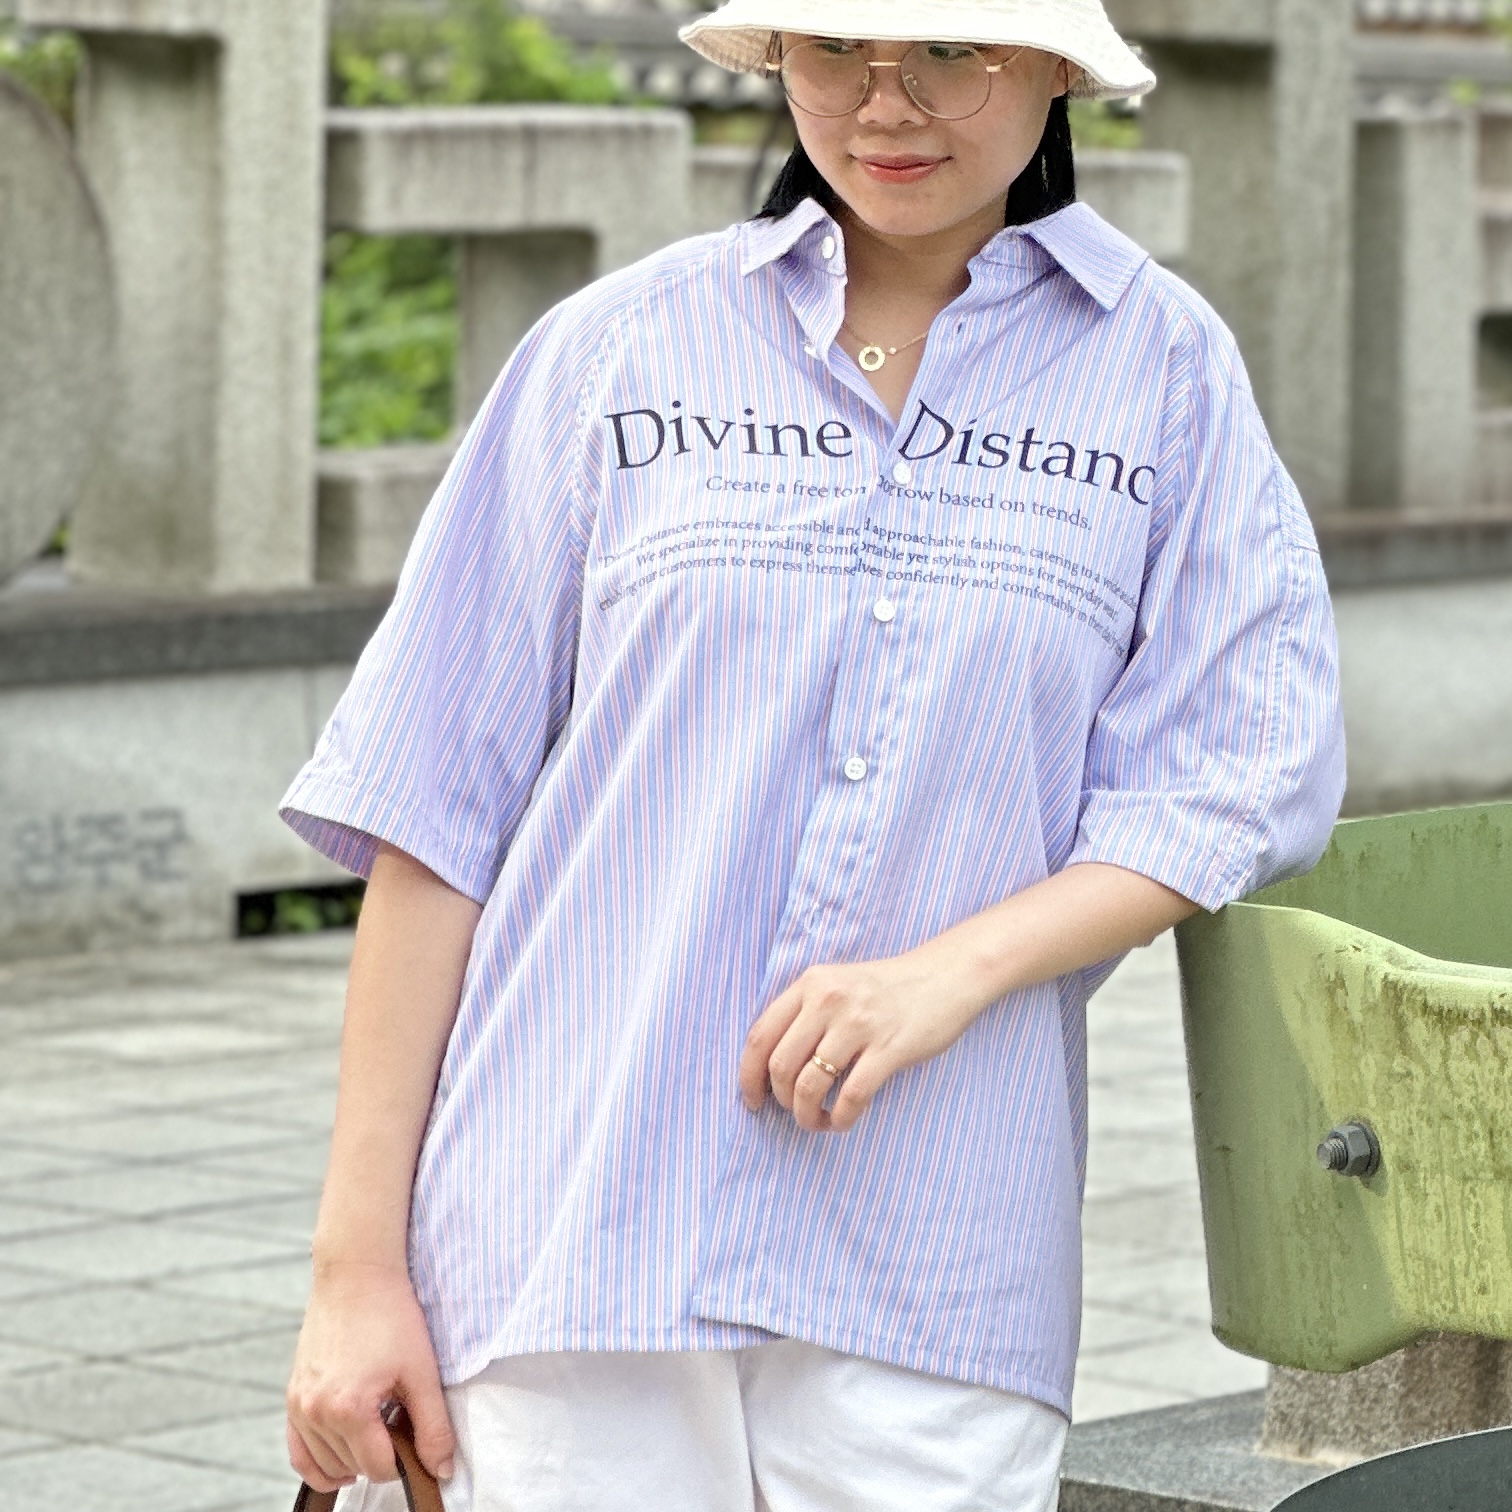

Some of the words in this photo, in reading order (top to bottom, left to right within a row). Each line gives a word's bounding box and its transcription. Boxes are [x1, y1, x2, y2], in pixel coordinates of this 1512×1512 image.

[604, 400, 854, 470] Divine
[706, 475, 771, 494] Create
[776, 482, 786, 494] a
[793, 479, 830, 498] free
[939, 487, 994, 510] based
[1000, 498, 1025, 513] on
[1032, 500, 1092, 531] trends.
[636, 550, 656, 567] We
[658, 536, 720, 561] specialize
[724, 536, 737, 548] in
[742, 535, 814, 556] providing
[907, 551, 929, 565] yet
[933, 553, 976, 569] stylish
[981, 560, 1035, 577] options
[1037, 566, 1055, 584] for
[640, 523, 690, 548] Distance
[693, 517, 761, 531] embraces
[764, 520, 834, 534] accessible
[872, 524, 966, 548] approachable
[1029, 547, 1079, 577] catering
[1082, 565, 1093, 579] to
[638, 570, 658, 587] our
[659, 555, 727, 578] customers
[731, 555, 746, 568] to
[750, 560, 803, 574] express
[806, 557, 883, 576] themselves
[886, 569, 968, 590] confidently
[971, 577, 999, 590] and
[1002, 581, 1078, 619] comfortably
